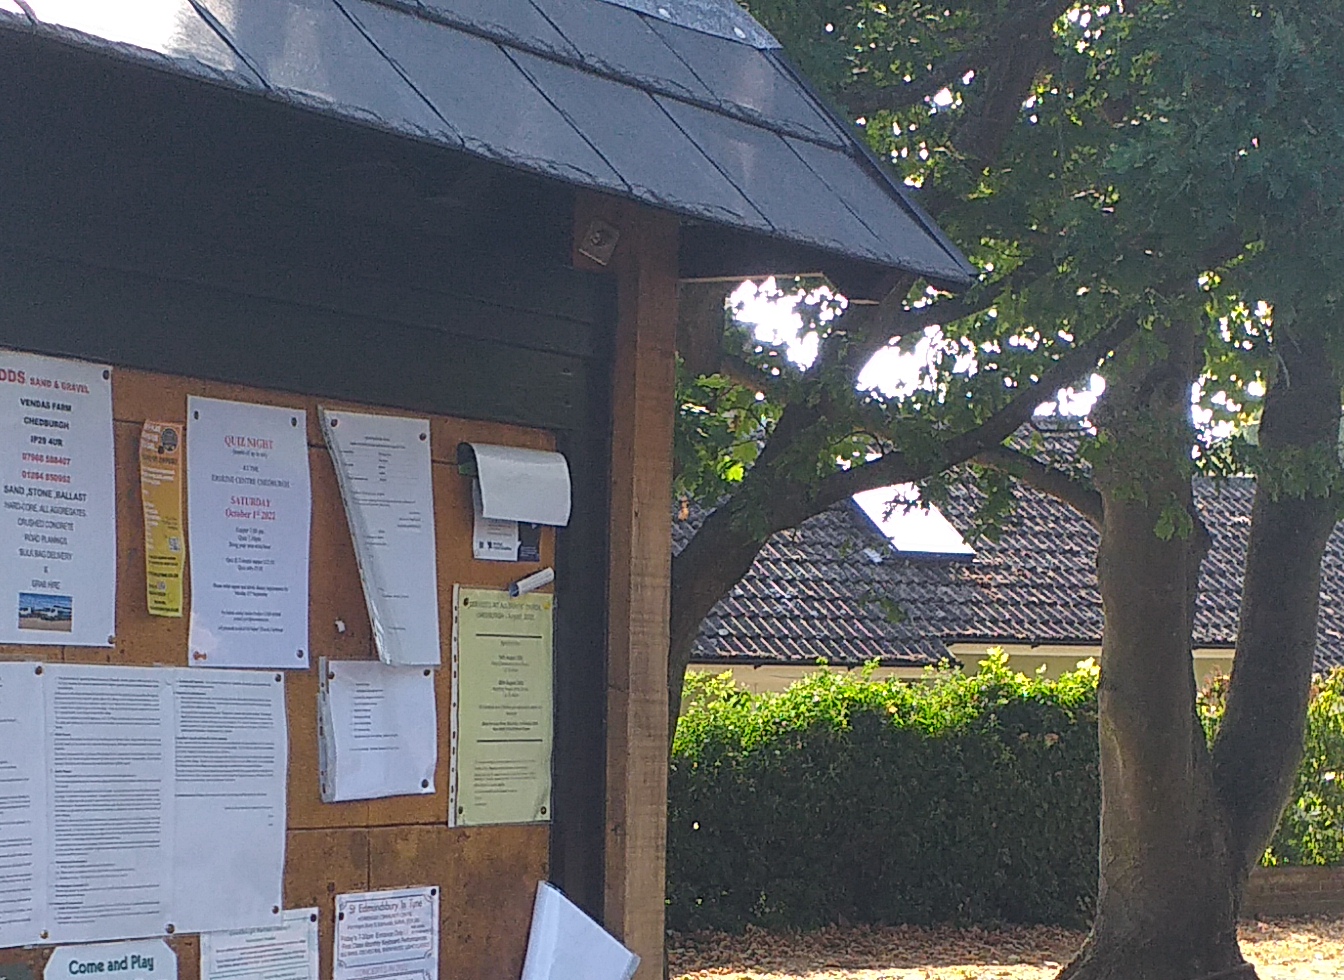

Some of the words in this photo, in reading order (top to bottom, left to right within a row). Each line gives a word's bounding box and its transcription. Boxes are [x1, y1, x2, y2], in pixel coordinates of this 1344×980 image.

[29, 377, 52, 389] SAND
[61, 382, 90, 394] GRAVEL
[19, 398, 51, 410] VENDAS
[52, 402, 72, 412] FARM
[23, 416, 70, 430] CHEDBURGH
[30, 435, 47, 445] IP29
[47, 437, 63, 447] 4UR
[224, 435, 246, 448] QUIZ
[246, 437, 274, 450] NIGHT
[3, 485, 25, 495] SAND
[230, 495, 271, 508] SATURDAY
[224, 508, 252, 519] October
[45, 520, 74, 531] CONCRETE
[68, 959, 105, 975] Come
[107, 956, 128, 972] and
[130, 954, 155, 972] Play
